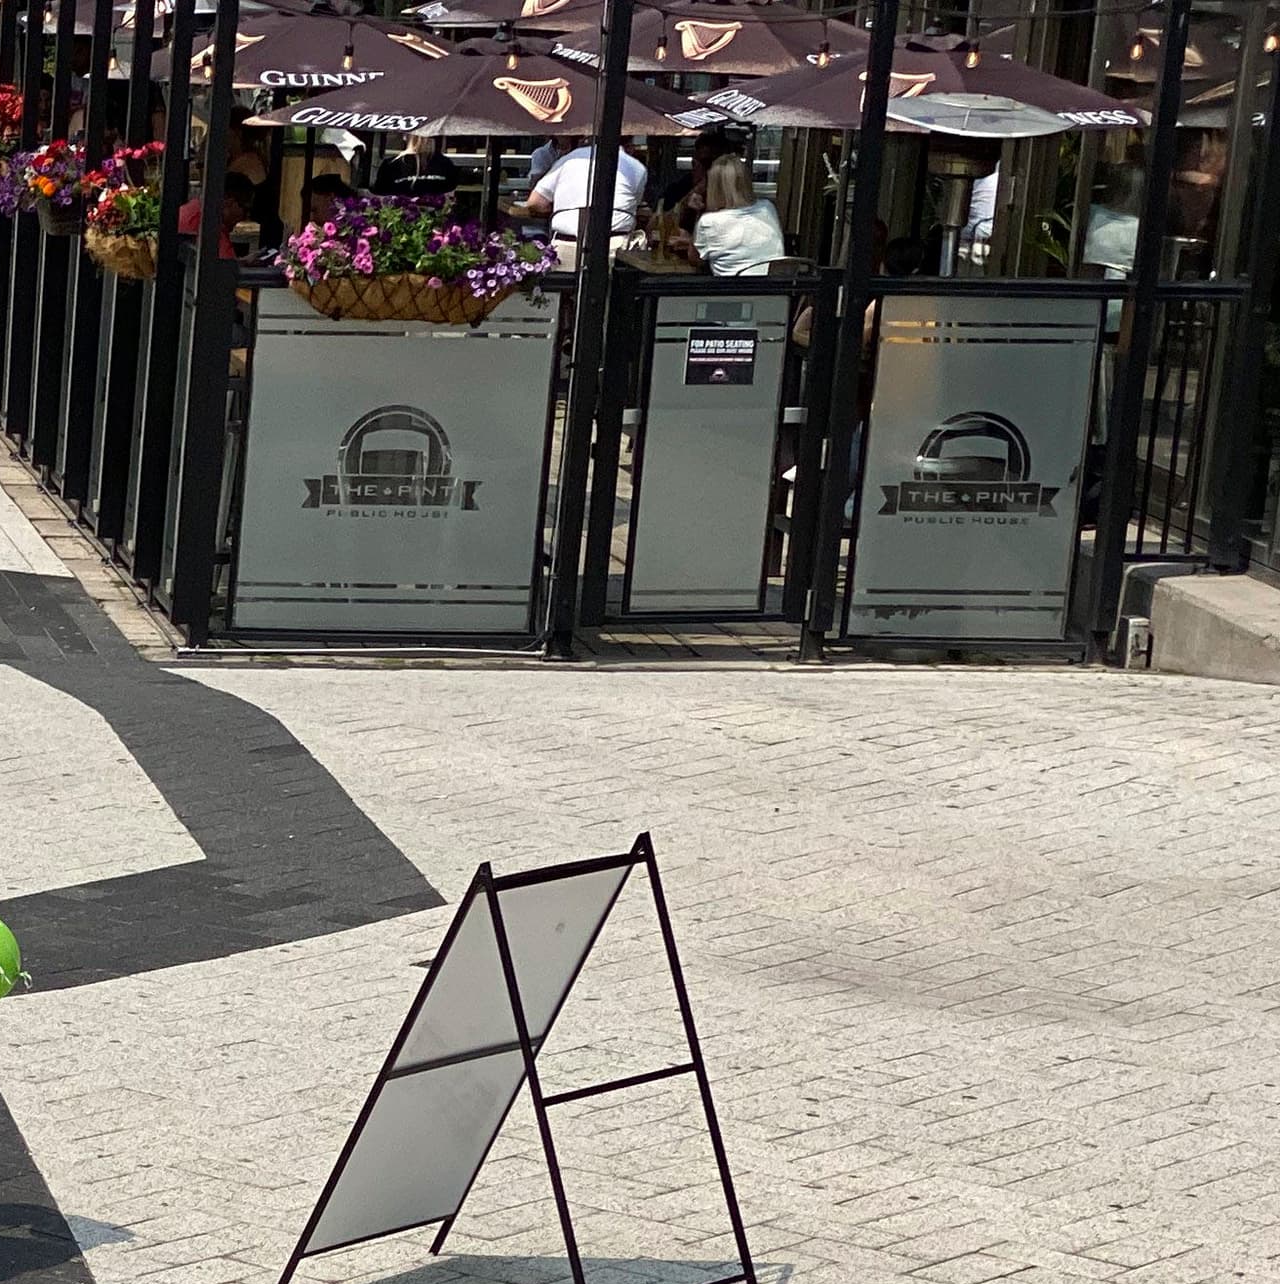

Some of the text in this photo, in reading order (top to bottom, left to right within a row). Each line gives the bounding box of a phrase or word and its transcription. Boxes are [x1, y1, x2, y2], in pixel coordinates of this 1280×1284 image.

[291, 107, 428, 131] GUINNESS
[329, 484, 378, 497] THE
[908, 491, 1034, 504] THE PINT
[903, 516, 1030, 526] PUBLIC HOUSE
